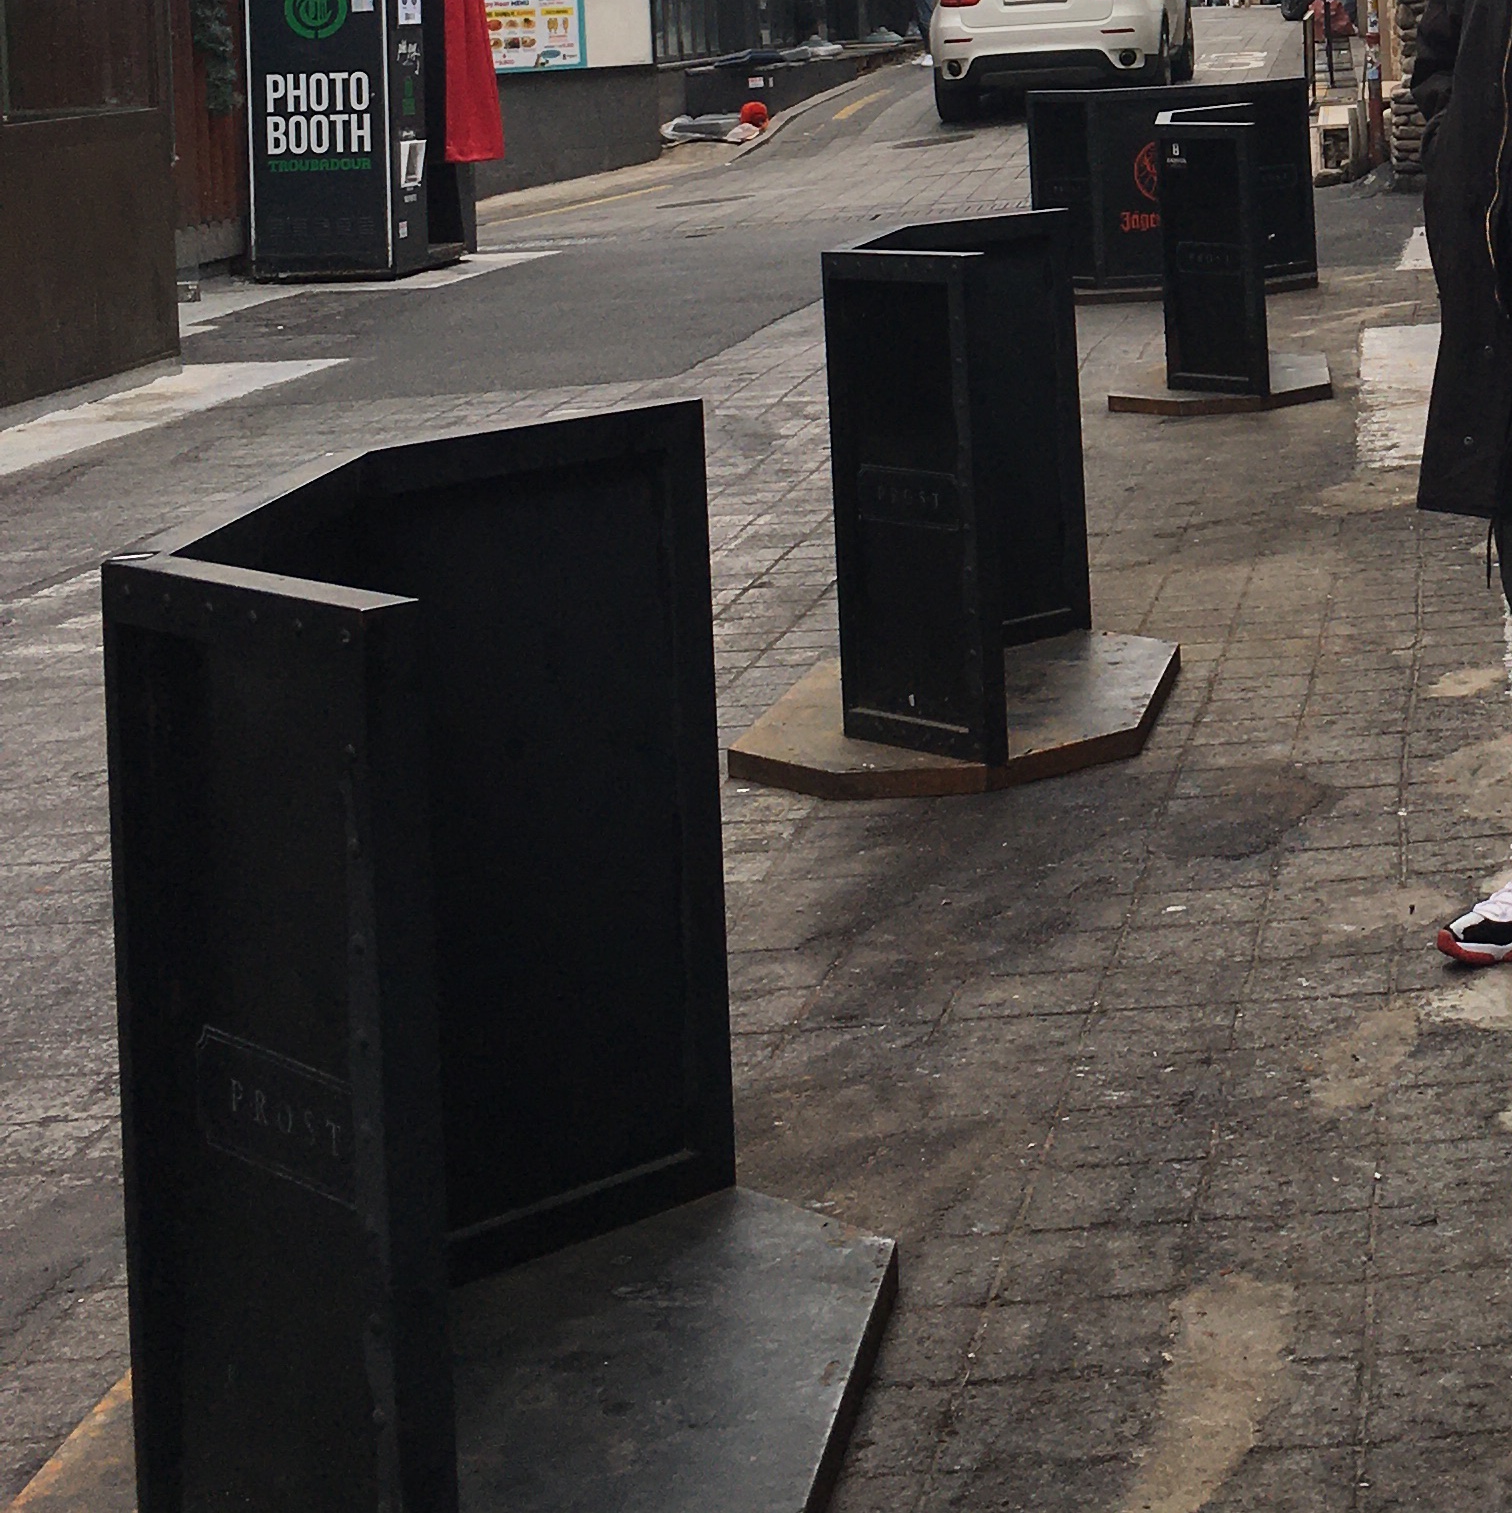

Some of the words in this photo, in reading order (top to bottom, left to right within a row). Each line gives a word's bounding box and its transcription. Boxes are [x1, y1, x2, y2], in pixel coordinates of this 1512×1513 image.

[266, 71, 370, 113] PHOTO
[266, 113, 372, 155] BOOTH
[268, 157, 372, 173] TROUBADOUR
[229, 1077, 342, 1157] PROST
